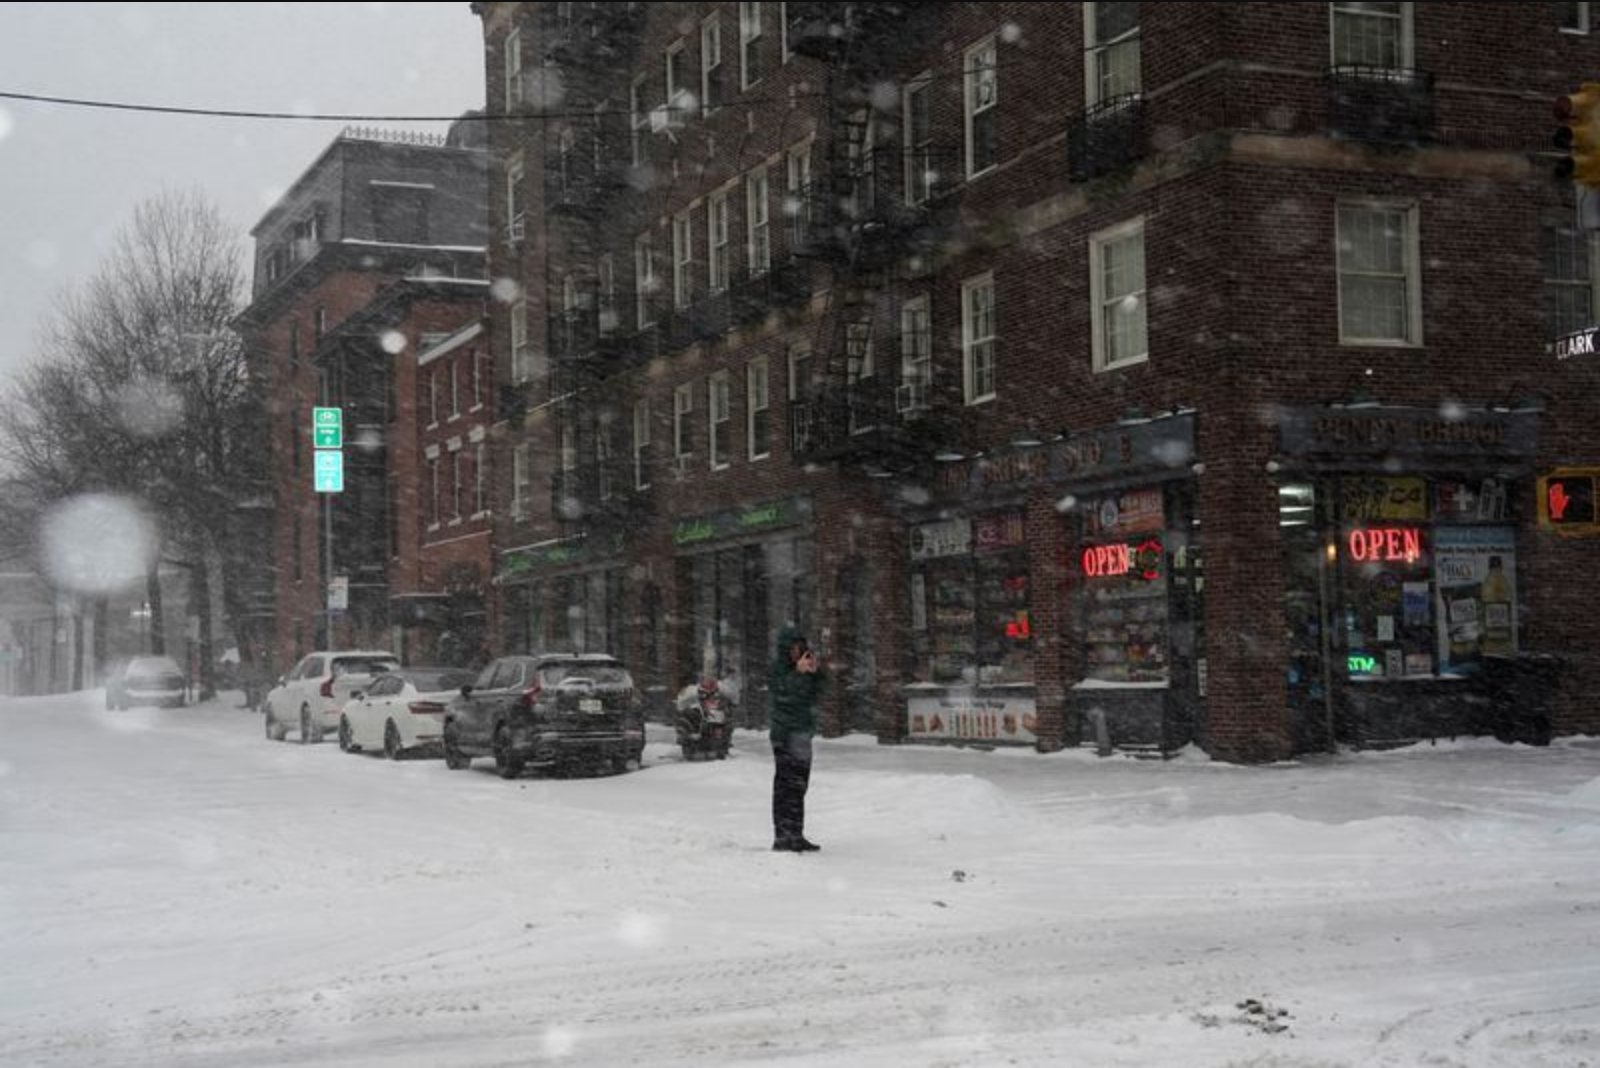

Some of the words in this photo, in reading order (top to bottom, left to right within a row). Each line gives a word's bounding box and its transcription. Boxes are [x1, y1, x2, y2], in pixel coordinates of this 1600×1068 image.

[1556, 333, 1594, 360] CLARK
[1083, 543, 1129, 576] OPEN
[1349, 528, 1420, 561] OPEN
